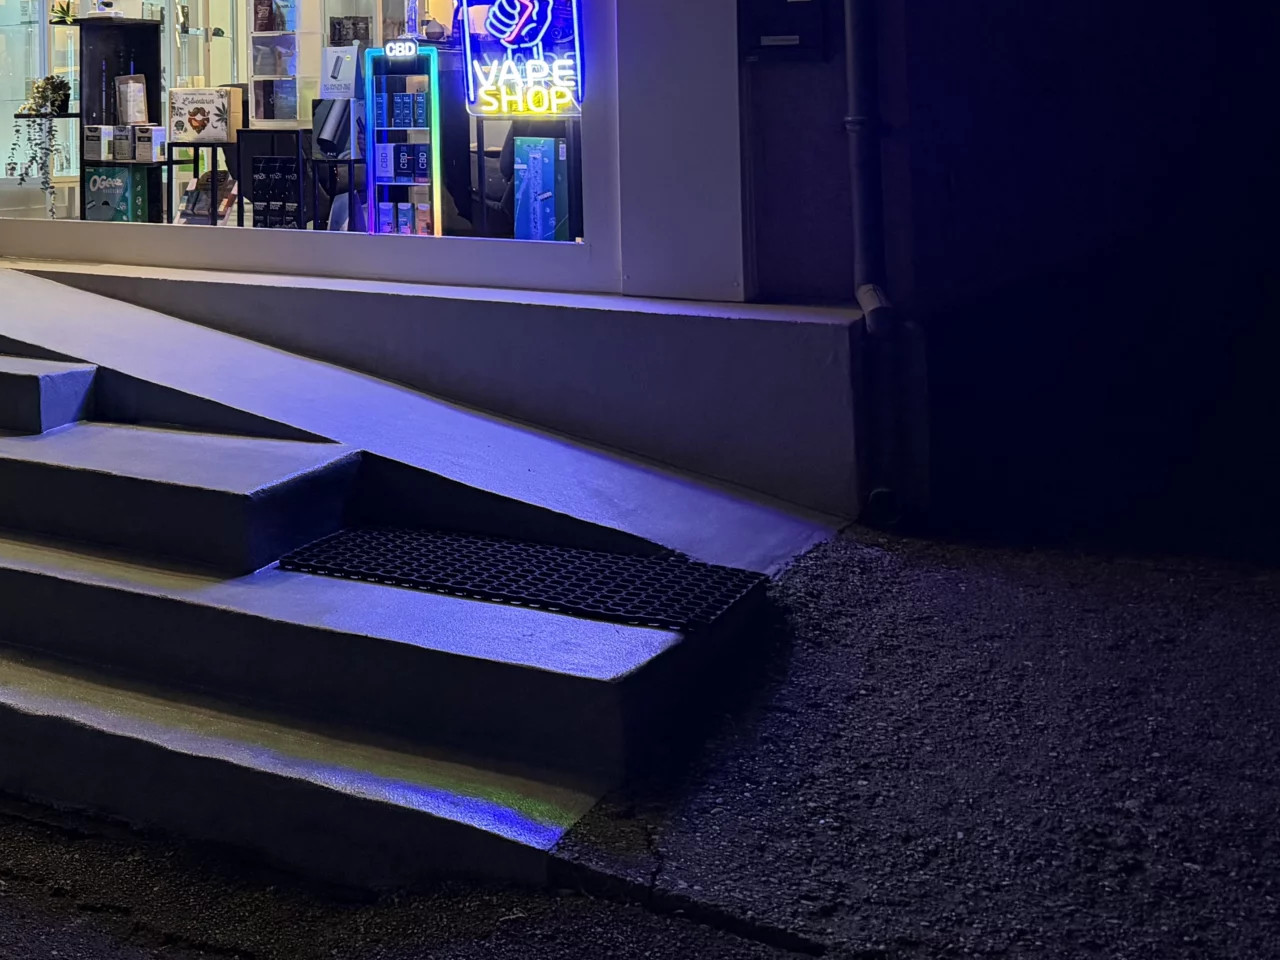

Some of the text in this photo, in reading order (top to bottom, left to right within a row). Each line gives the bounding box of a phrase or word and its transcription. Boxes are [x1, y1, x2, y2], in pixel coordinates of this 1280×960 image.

[385, 42, 416, 57] CBD
[472, 59, 577, 87] VAPE
[478, 85, 572, 113] SHOP
[380, 152, 388, 169] CBD
[400, 152, 408, 169] CBD
[419, 152, 427, 169] CBD
